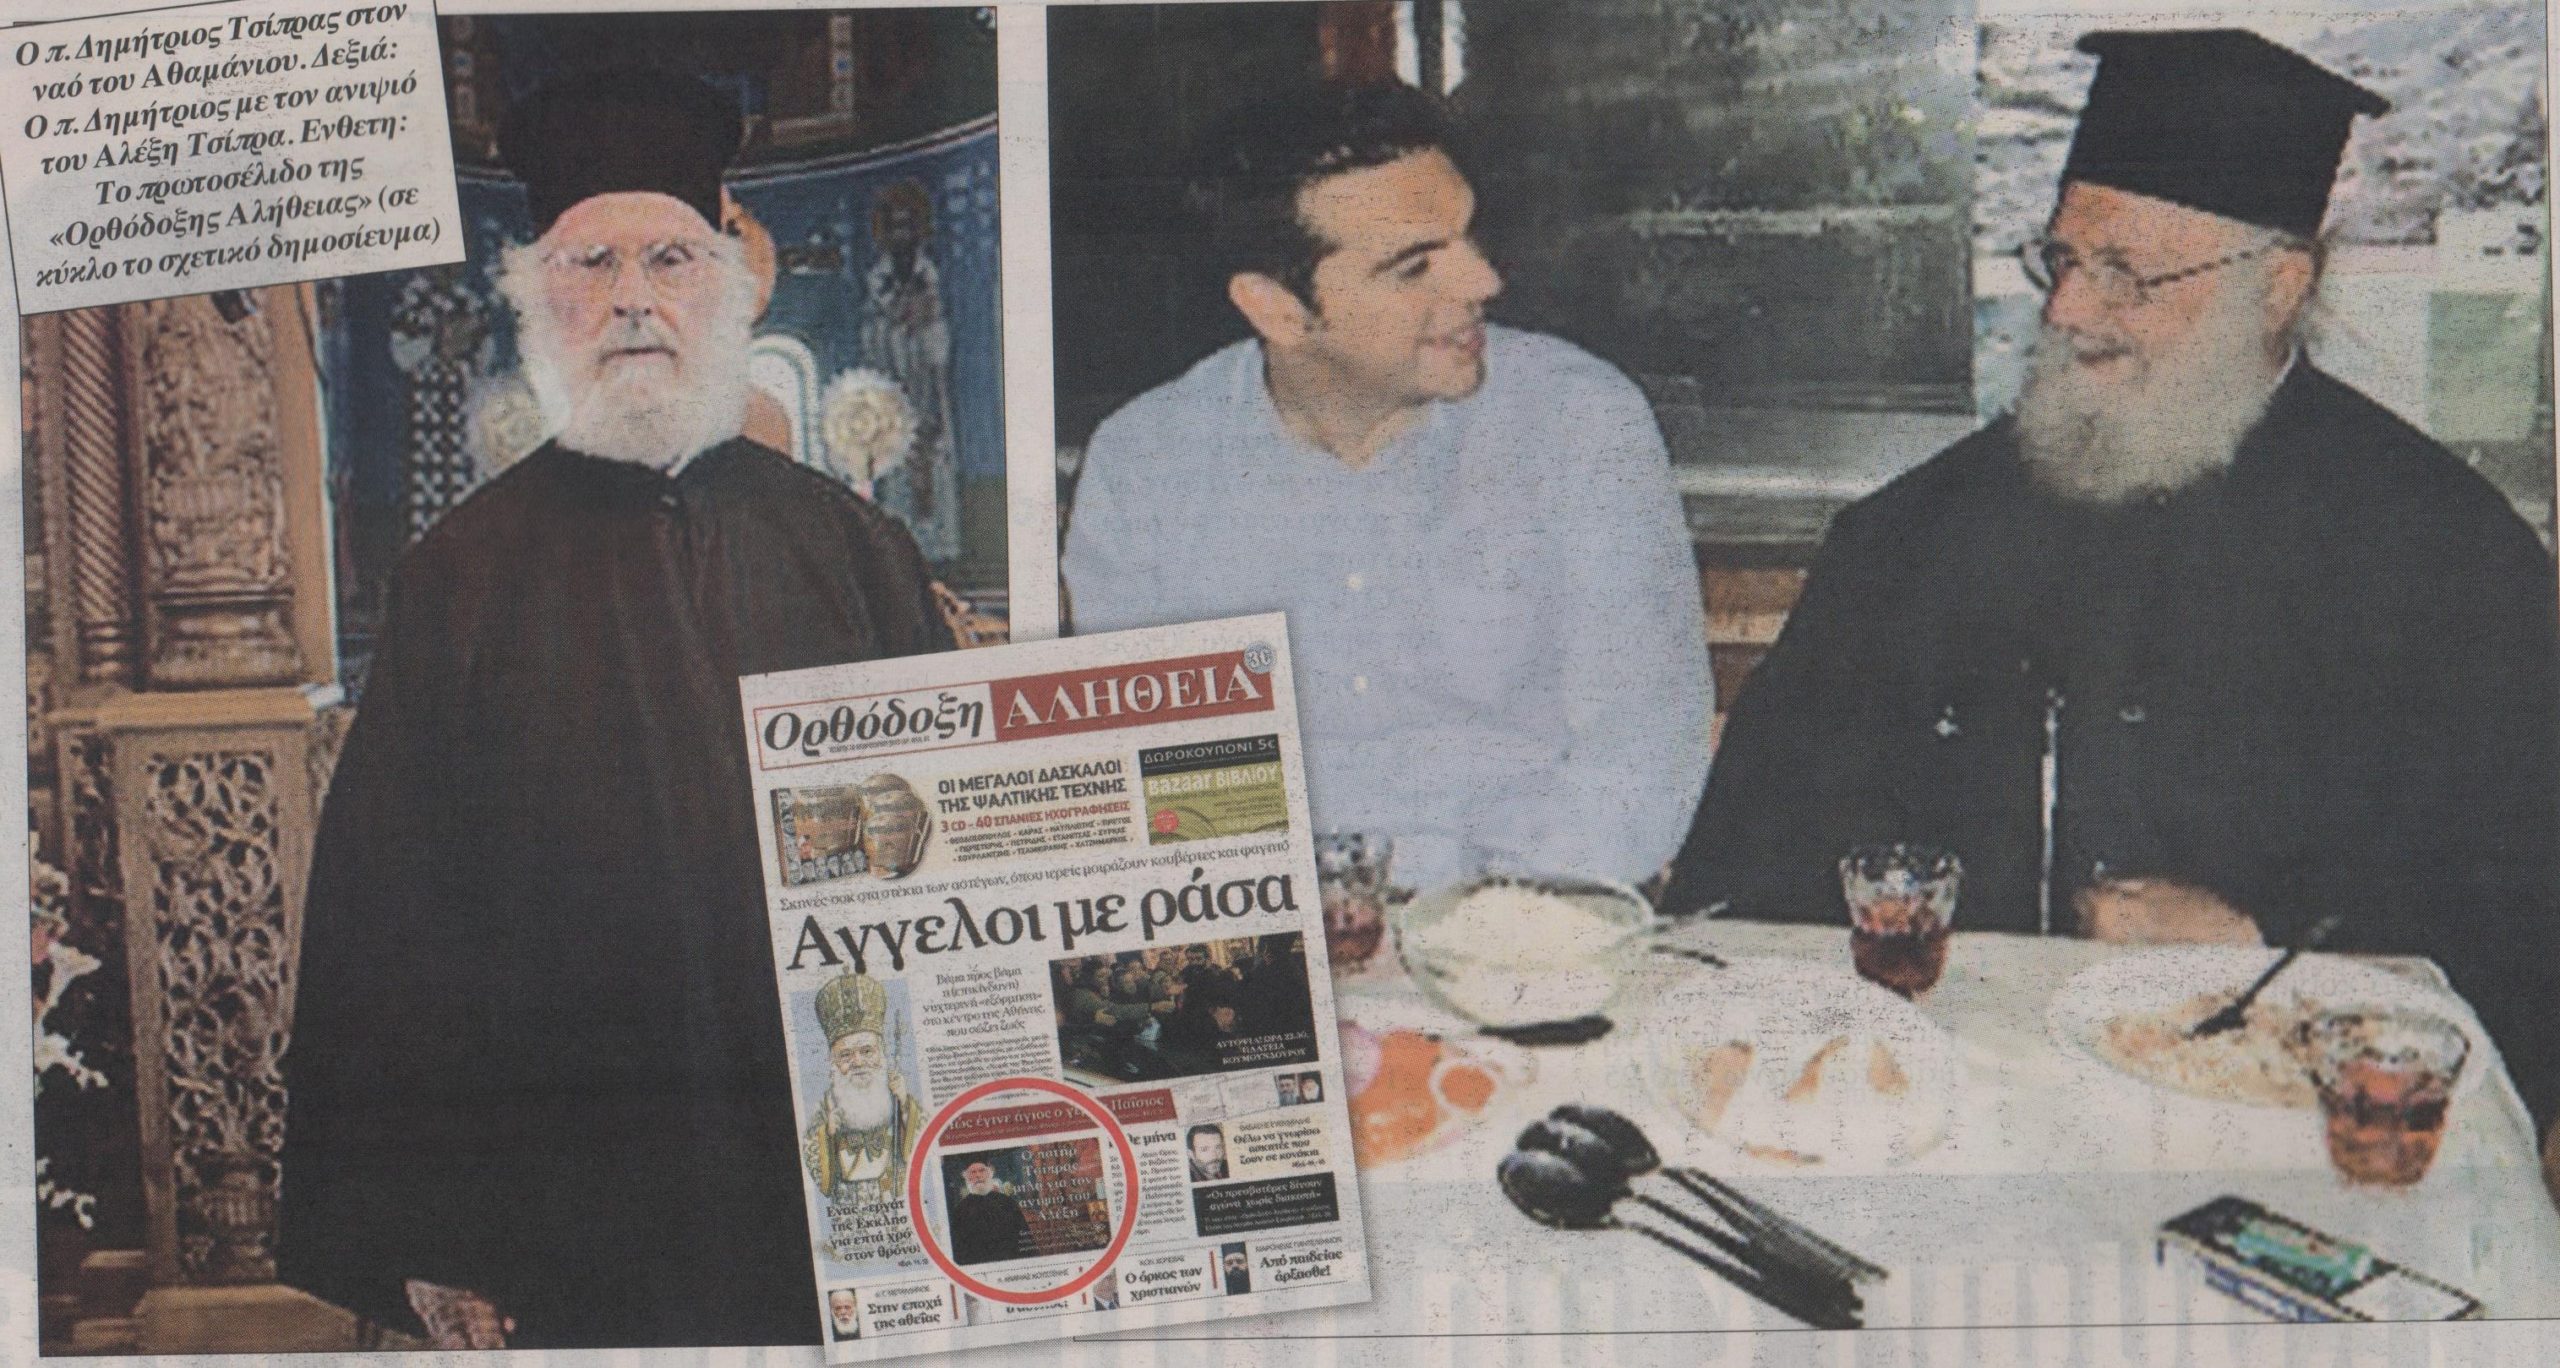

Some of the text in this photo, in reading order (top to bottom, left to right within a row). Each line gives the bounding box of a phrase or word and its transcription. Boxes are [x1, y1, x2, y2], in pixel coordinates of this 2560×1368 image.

[16, 42, 39, 66] Ο
[75, 23, 222, 60] Δημήτριος
[229, 7, 339, 40] Τσίπρας
[346, 3, 407, 25] στον
[33, 37, 397, 101] ναό του Αθαμάνιου. Δεξιά:
[24, 115, 48, 139] Ο
[83, 97, 229, 134] Δημήτριος
[236, 92, 269, 116] με
[274, 88, 318, 109] τον
[325, 71, 417, 105] ανιψιό
[41, 114, 407, 174] του Αλέξη Τσίπρα. Ενθετη:
[97, 154, 364, 205] Το πρωτοσέλιδο της
[50, 183, 418, 249] «Ορθόδοξης Αλήθειας» (σε
[36, 217, 439, 289] κύκλο το σχετικό δημοσίευμα)
[764, 664, 1263, 756] Ορθόδοξη ΑΛΗΘΕΙΑ
[1144, 742, 1252, 764] ΔΩΡΟΚΟΥΠΟΝΙ
[1258, 739, 1275, 750] 5€
[939, 760, 1120, 794] ΟΙ ΜΕΓΑΛΟΙ ΔΑΣΚΑΛΟΙ
[939, 778, 1126, 813] ΤΗΣ ΨΑΛΤΙΚΗΣ ΤΕΧΝΗΣ
[941, 821, 948, 832] 3
[951, 820, 965, 831] CD
[976, 816, 992, 828] 40
[995, 812, 1043, 825] ΣΠΑΝΙΕΣ
[1045, 801, 1130, 821] ΗΧΟΓΡΑΦΗΣΕΙΣ
[781, 893, 827, 911] Σκηνές
[927, 881, 947, 892] των
[1083, 857, 1149, 877] μοιράζουν
[1151, 850, 1216, 867] κουβέρτες
[1218, 848, 1239, 860] και
[786, 867, 1298, 973] Αγγελοι με ράσα
[844, 1250, 874, 1261] στον
[1125, 1267, 1202, 1285] Ο όρκος των
[1260, 1255, 1287, 1268] Από
[868, 1296, 942, 1314] Στην εποχή
[1131, 1282, 1201, 1301] χριστιανών
[874, 1319, 896, 1330] της
